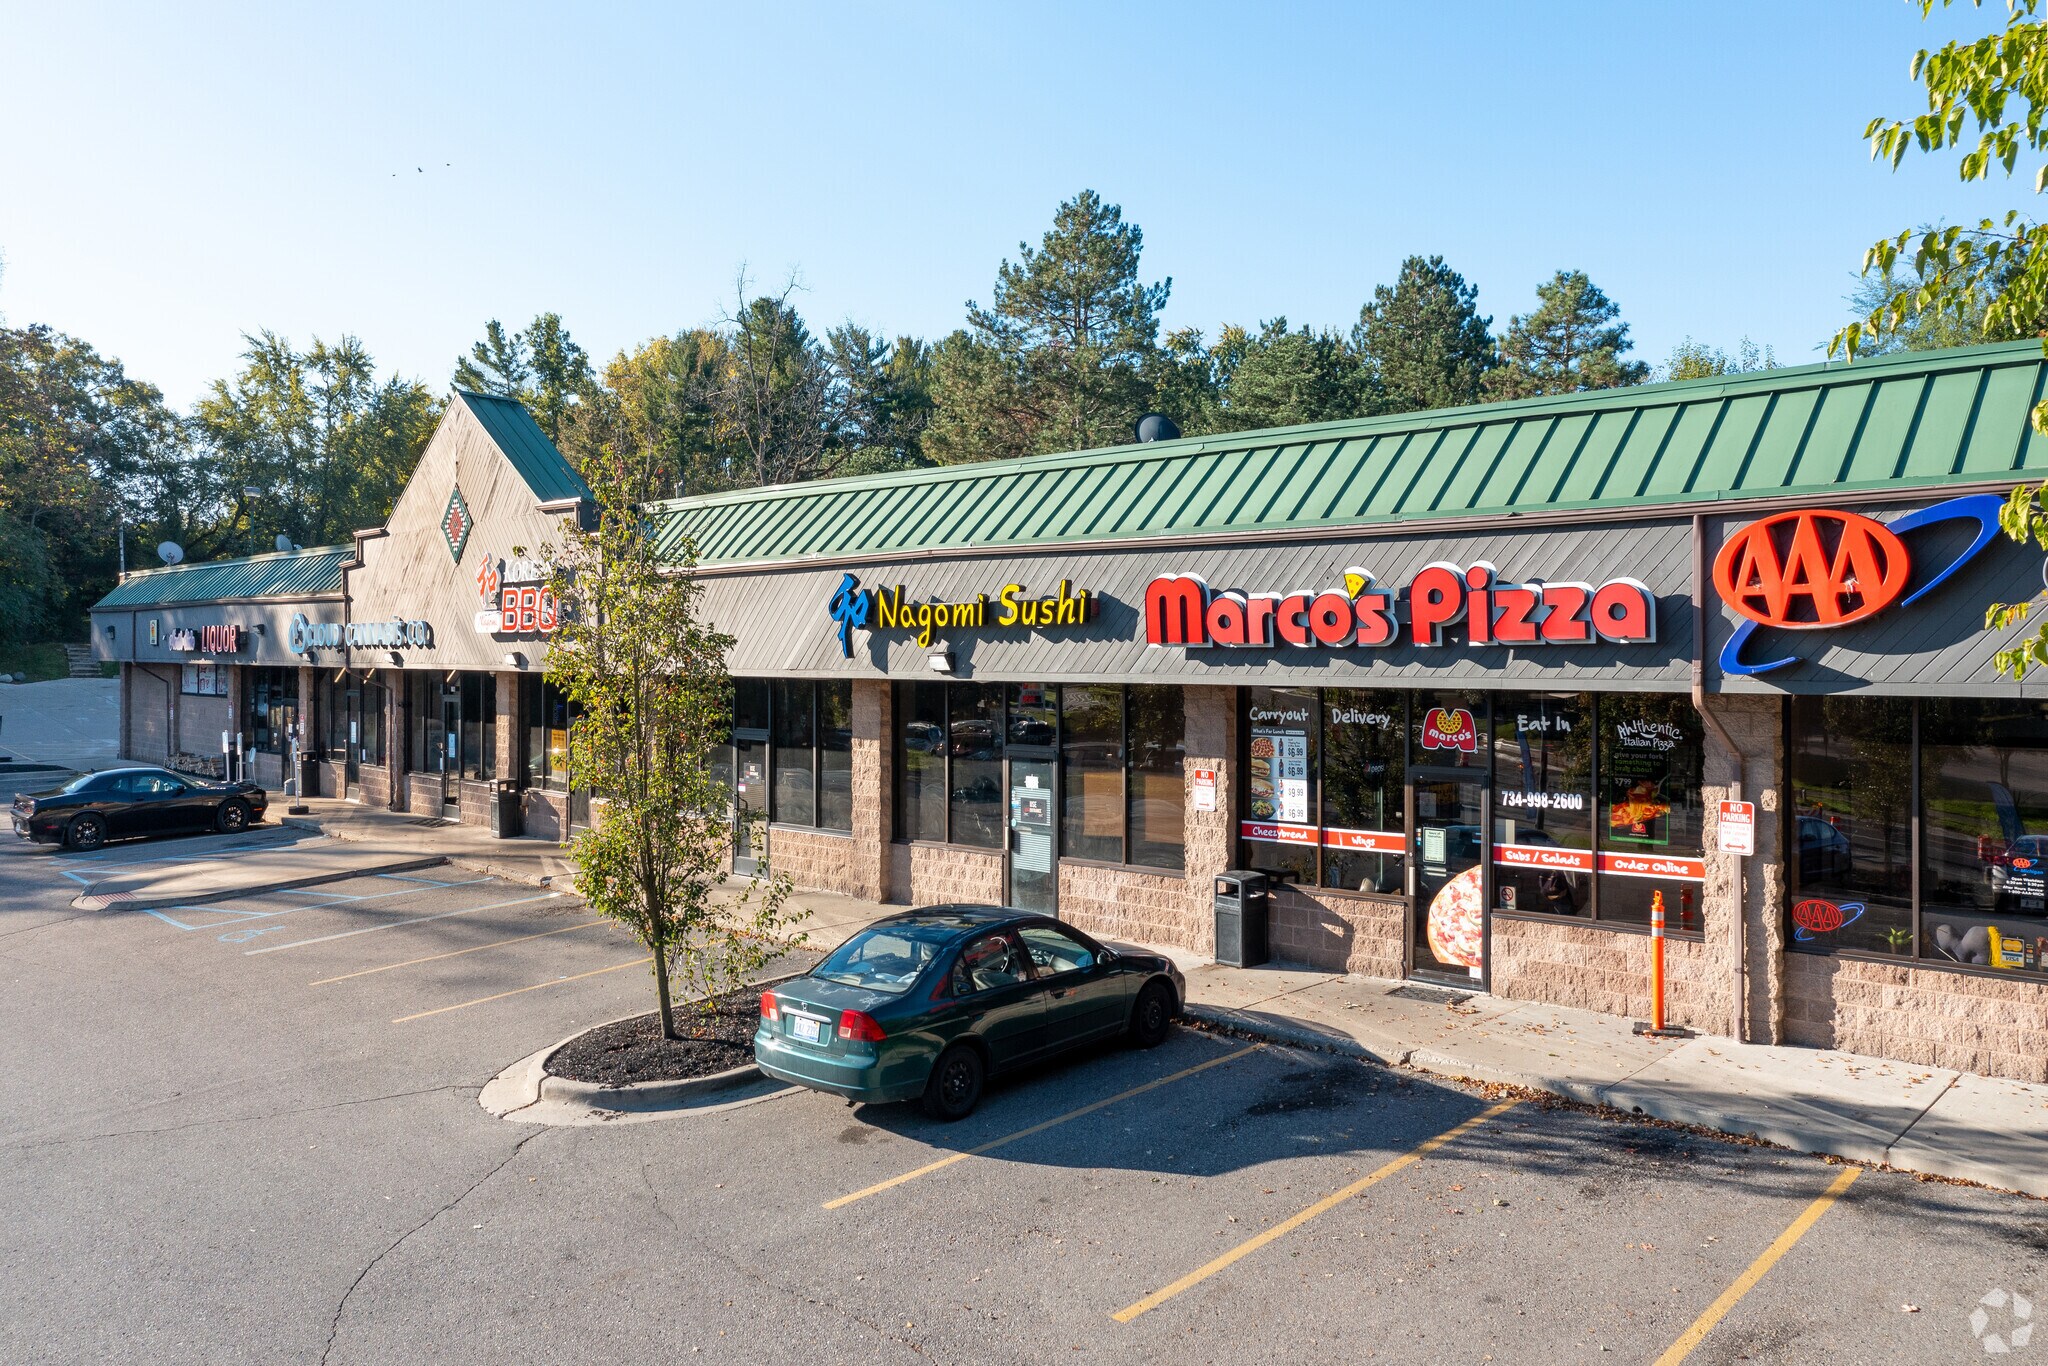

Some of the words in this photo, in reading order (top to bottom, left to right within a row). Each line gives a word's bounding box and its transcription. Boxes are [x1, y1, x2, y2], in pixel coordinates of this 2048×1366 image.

[1718, 509, 1902, 628] AAA
[502, 586, 559, 632] BBQ
[1409, 561, 1658, 647] Pizza
[878, 585, 984, 648] Nagomi
[998, 580, 1086, 625] Sushi
[202, 625, 237, 655] LIQUOR
[307, 623, 342, 647] CLOUD
[345, 620, 404, 647] CANNABIS
[1249, 707, 1309, 724] Carryout
[1332, 708, 1390, 729] Delivery
[1517, 714, 1550, 731] Eat
[1556, 715, 1571, 731] In
[1623, 737, 1651, 747] Italian
[1652, 737, 1676, 751] Pizza
[1200, 771, 1209, 779] NO
[1501, 790, 1583, 810] 734-998-2600
[1730, 803, 1743, 814] NO
[1722, 812, 1751, 823] PARKING
[1252, 827, 1308, 840] Cheezybread
[1505, 850, 1530, 862] Subs
[1542, 853, 1580, 866] Salads
[1614, 859, 1649, 870] Order
[1652, 860, 1689, 875] Online
[1796, 901, 1840, 930] AAA
